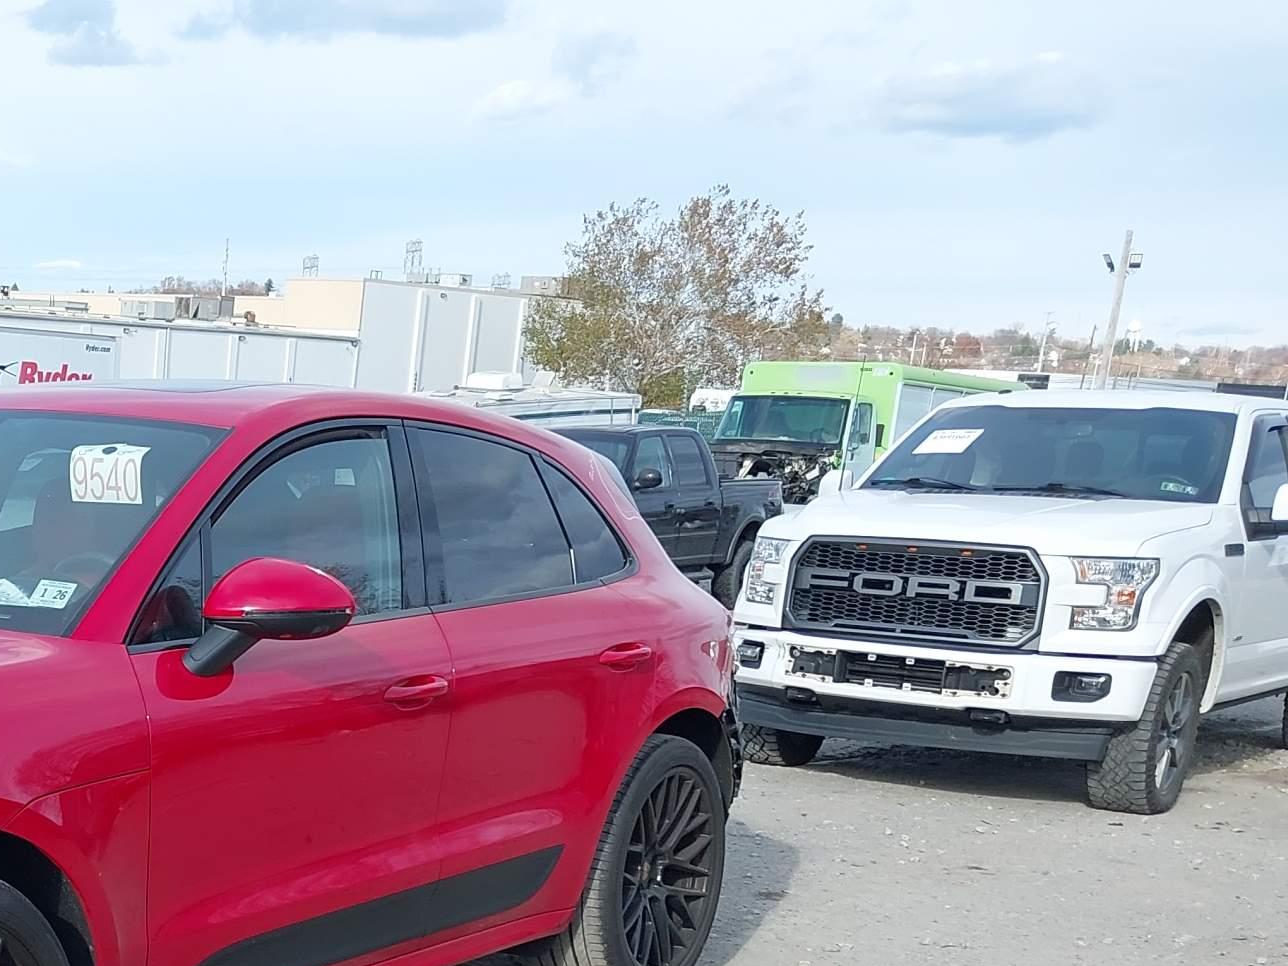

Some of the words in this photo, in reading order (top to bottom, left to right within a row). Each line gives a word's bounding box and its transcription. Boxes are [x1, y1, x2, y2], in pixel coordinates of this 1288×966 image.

[73, 456, 139, 502] 9540
[52, 589, 68, 601] 26
[798, 567, 1024, 605] FORD
